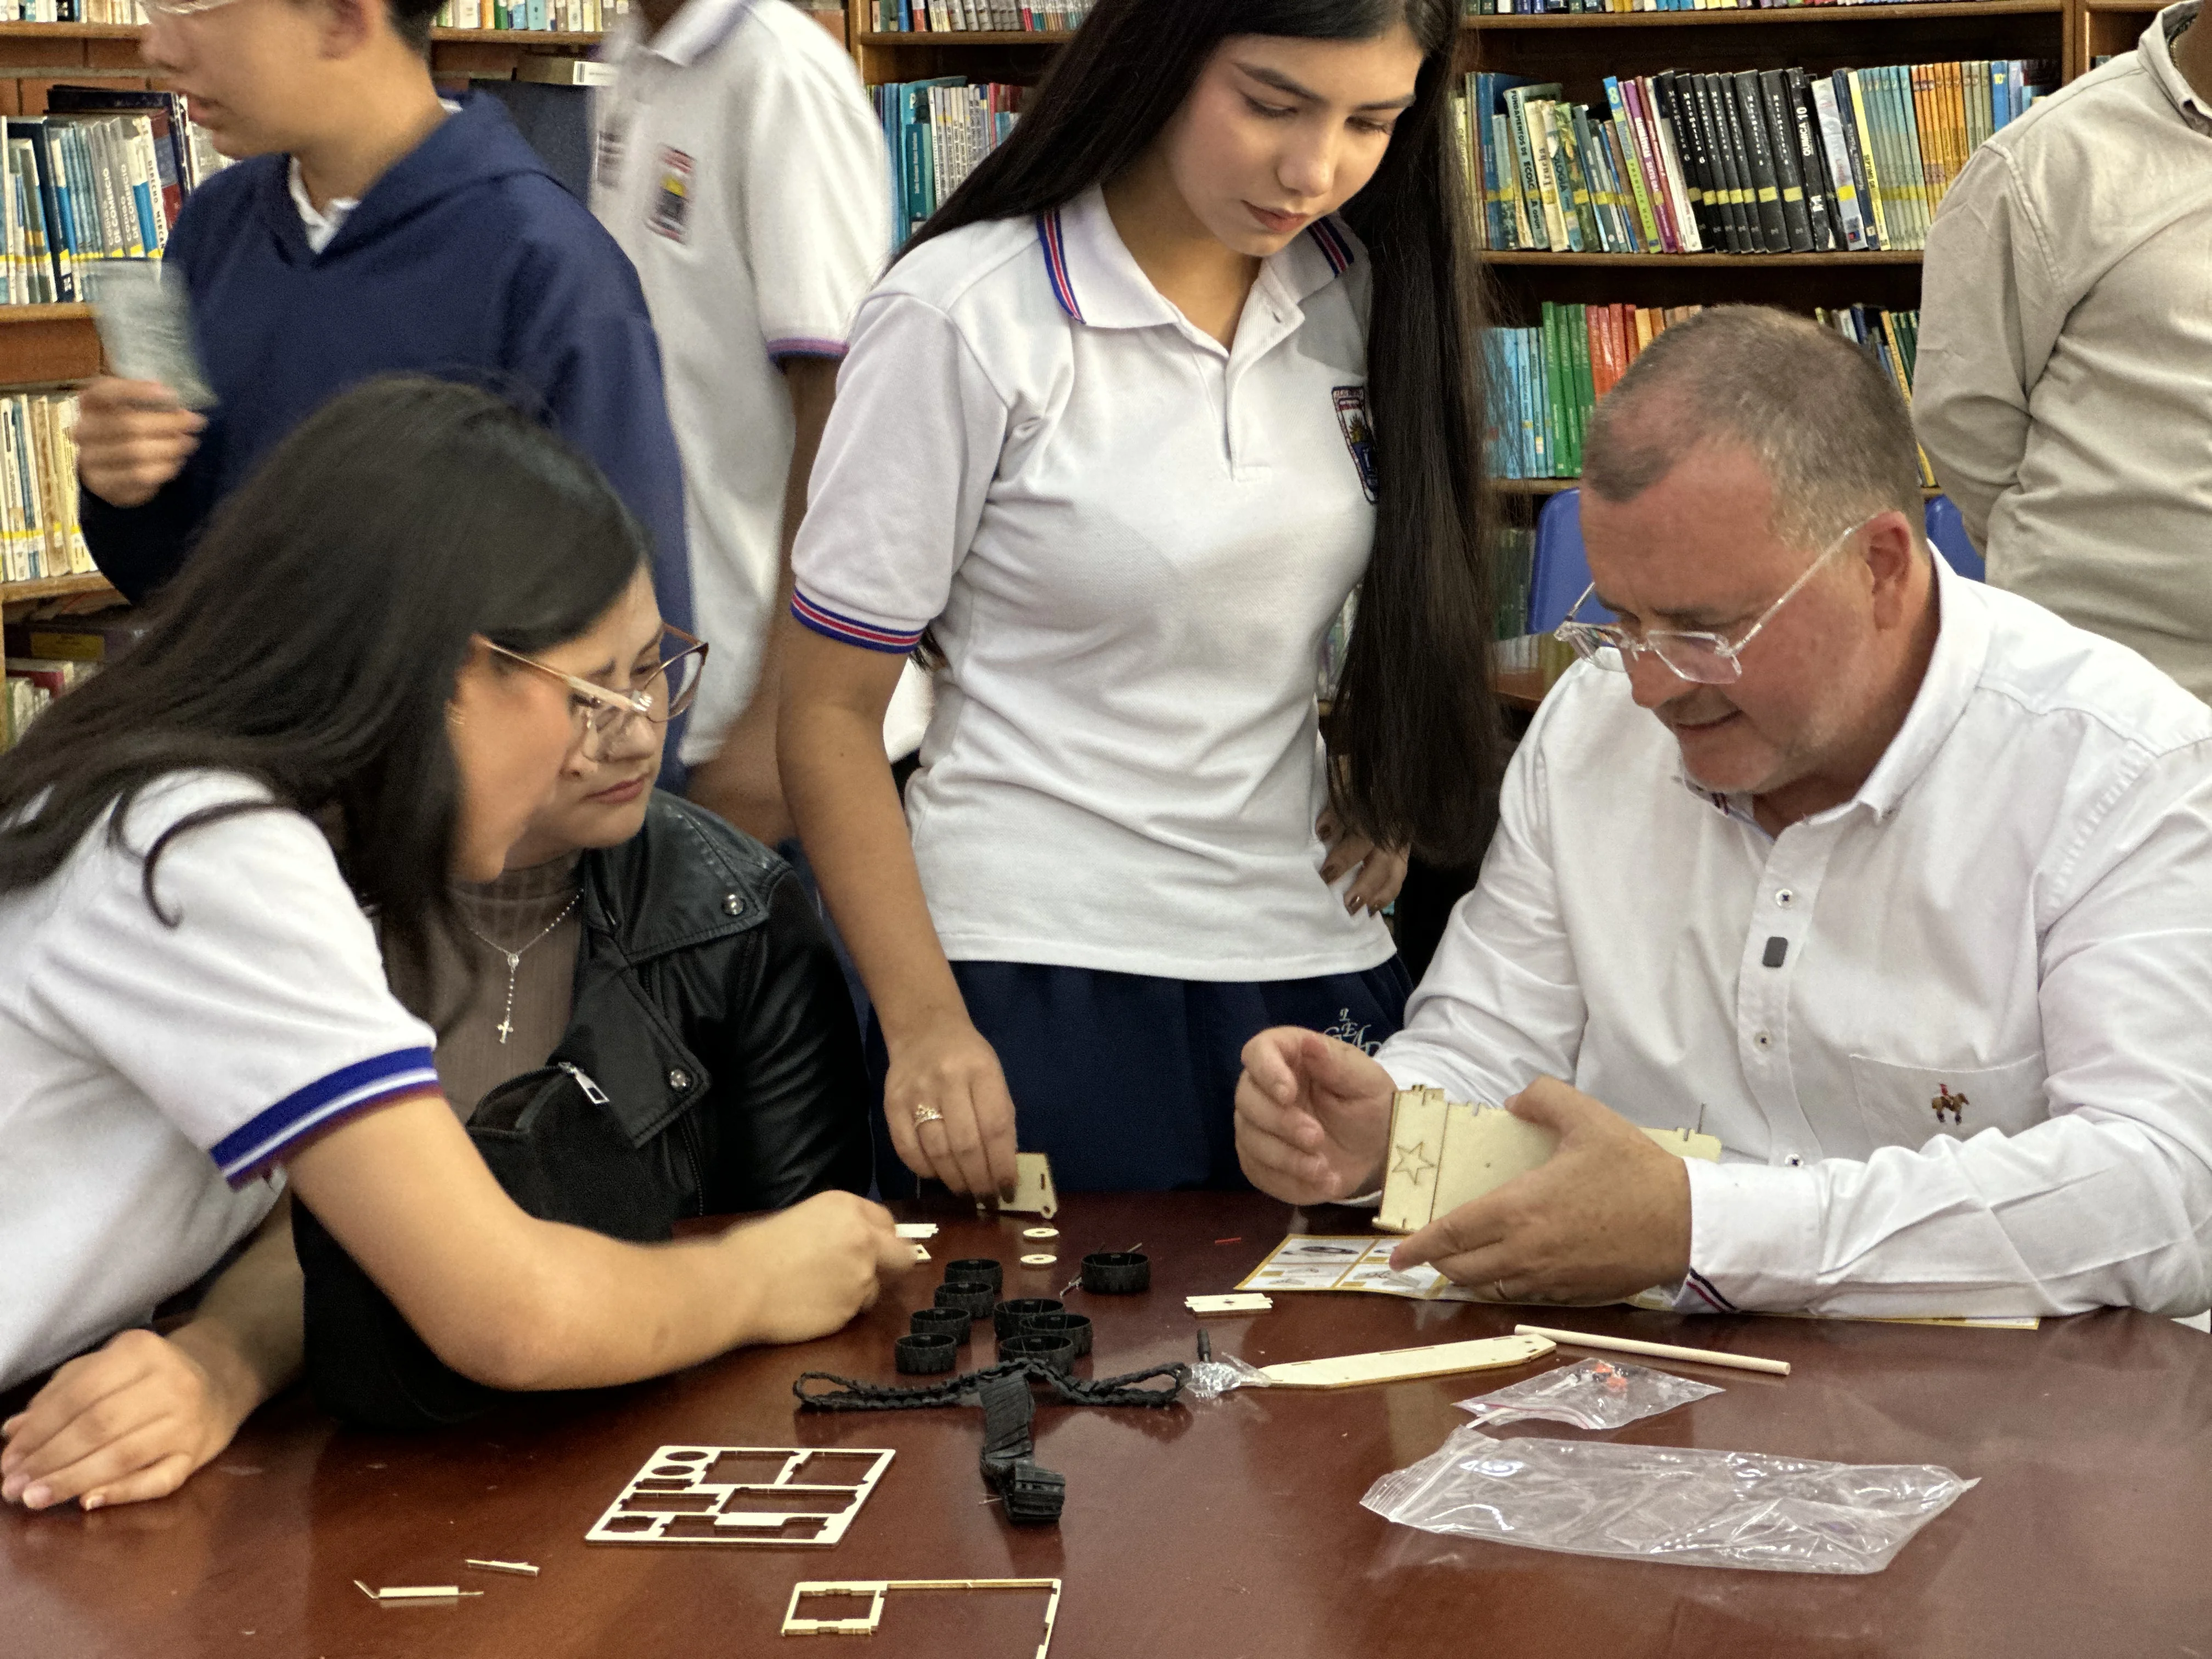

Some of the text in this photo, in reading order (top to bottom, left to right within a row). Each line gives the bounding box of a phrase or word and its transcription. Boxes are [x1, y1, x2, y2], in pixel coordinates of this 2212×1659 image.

[1608, 86, 1620, 104] 8
[1796, 106, 1809, 121] 10
[1510, 91, 1526, 145] FUNDAMENTOS
[1521, 146, 1527, 156] DE
[103, 168, 120, 243] DE COMERCIO
[121, 165, 136, 222] COMERCIO
[148, 160, 159, 204] DERECHO
